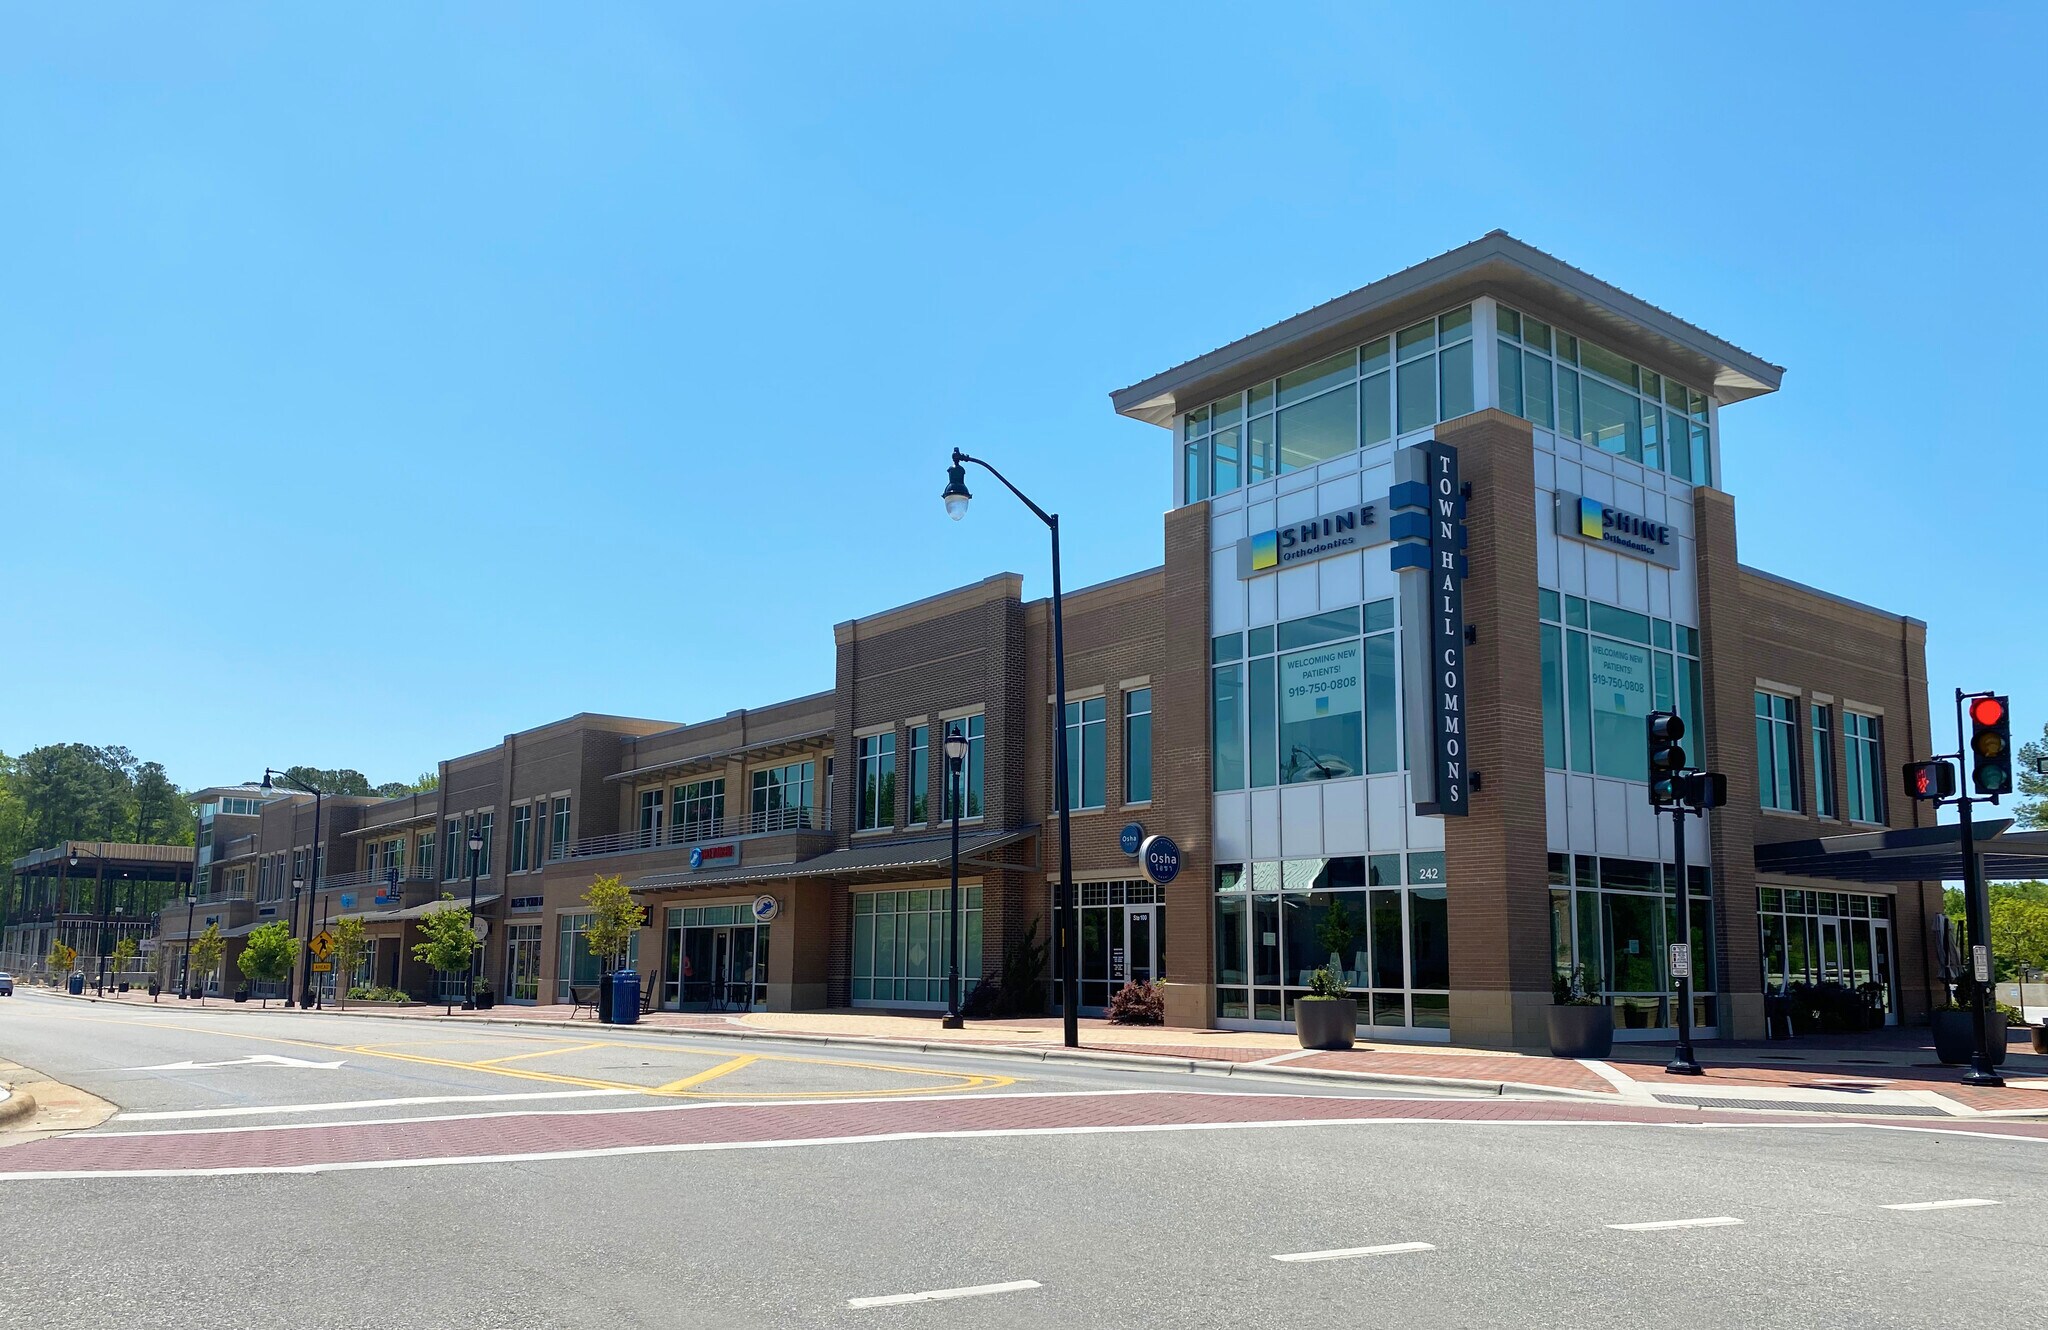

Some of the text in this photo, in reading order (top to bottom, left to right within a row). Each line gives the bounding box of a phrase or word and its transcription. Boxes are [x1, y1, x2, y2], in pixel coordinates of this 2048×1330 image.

[1282, 505, 1376, 548] SHINE
[1602, 508, 1670, 546] SHINE
[1283, 536, 1354, 561] Orthodontics
[1603, 532, 1655, 555] Orthodontics
[1438, 455, 1460, 802] TOWN HALL COMMONS
[1287, 648, 1357, 670] WELCOMING NEW
[1592, 645, 1643, 664] WELCOMING NEW
[1302, 665, 1341, 680] PATIENTS!
[1603, 661, 1632, 675] PATIENTS!
[1288, 676, 1357, 698] 919-750-0808
[1592, 673, 1645, 693] 919-750-0808
[1122, 834, 1137, 843] Osha
[1150, 852, 1177, 865] Osha
[1419, 868, 1439, 880] 242
